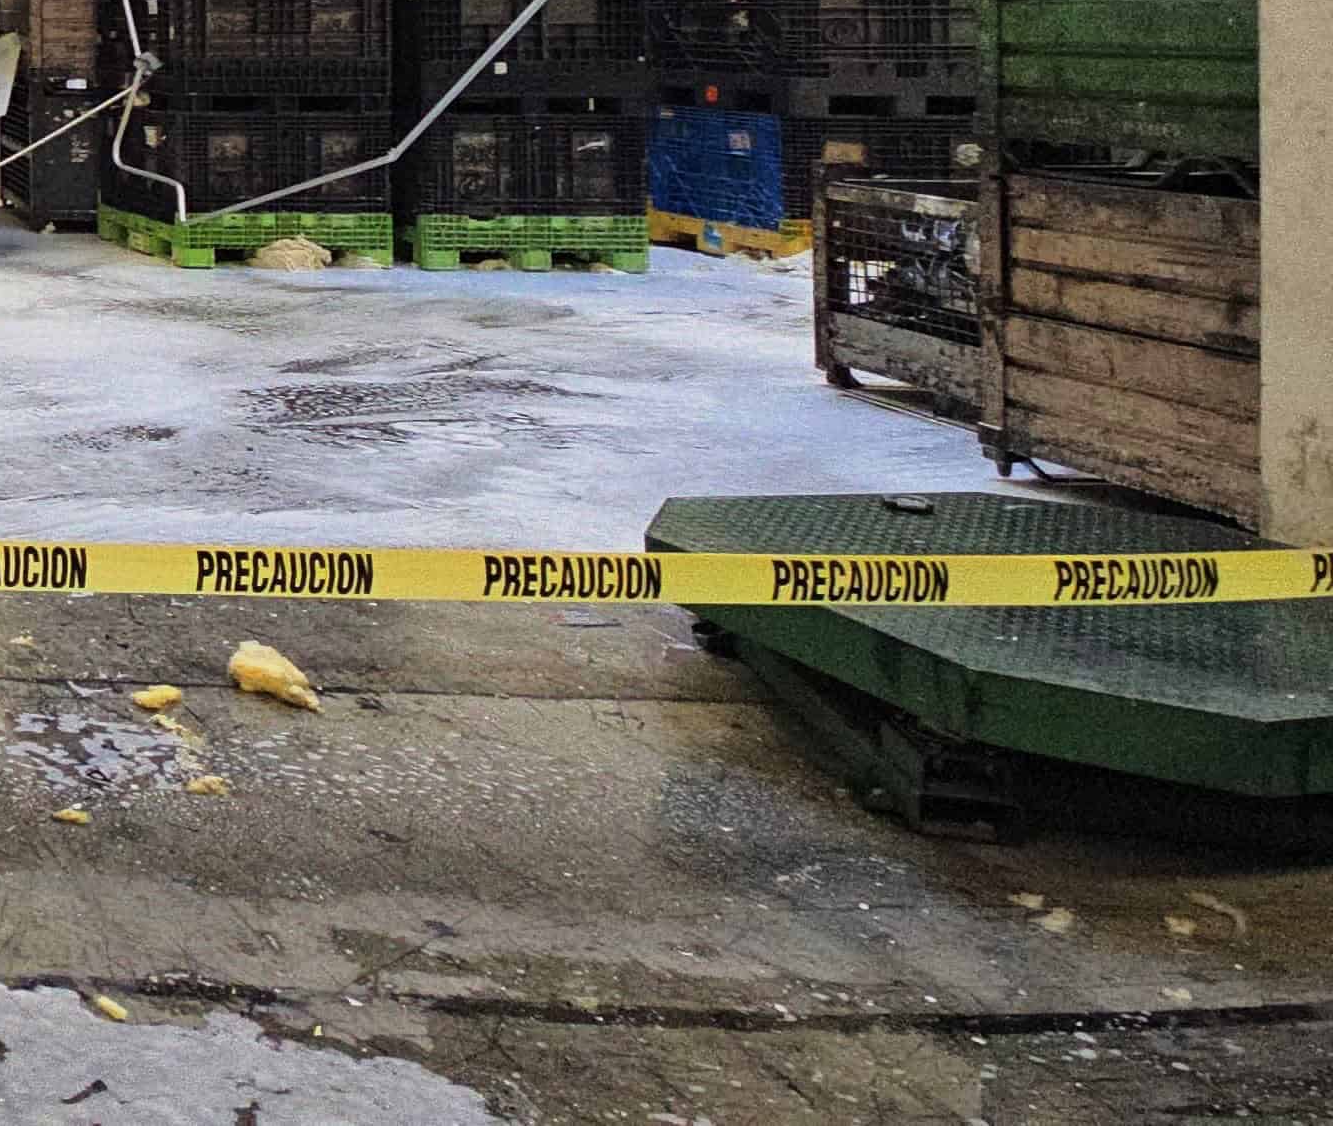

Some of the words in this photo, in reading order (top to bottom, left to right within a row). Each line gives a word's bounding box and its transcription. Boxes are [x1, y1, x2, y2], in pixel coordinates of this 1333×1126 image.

[197, 551, 373, 594] PRECAUCION
[484, 556, 661, 598] PRECAUCION
[772, 560, 948, 601] PRECAUCION
[1054, 559, 1218, 600] PRECAUCION
